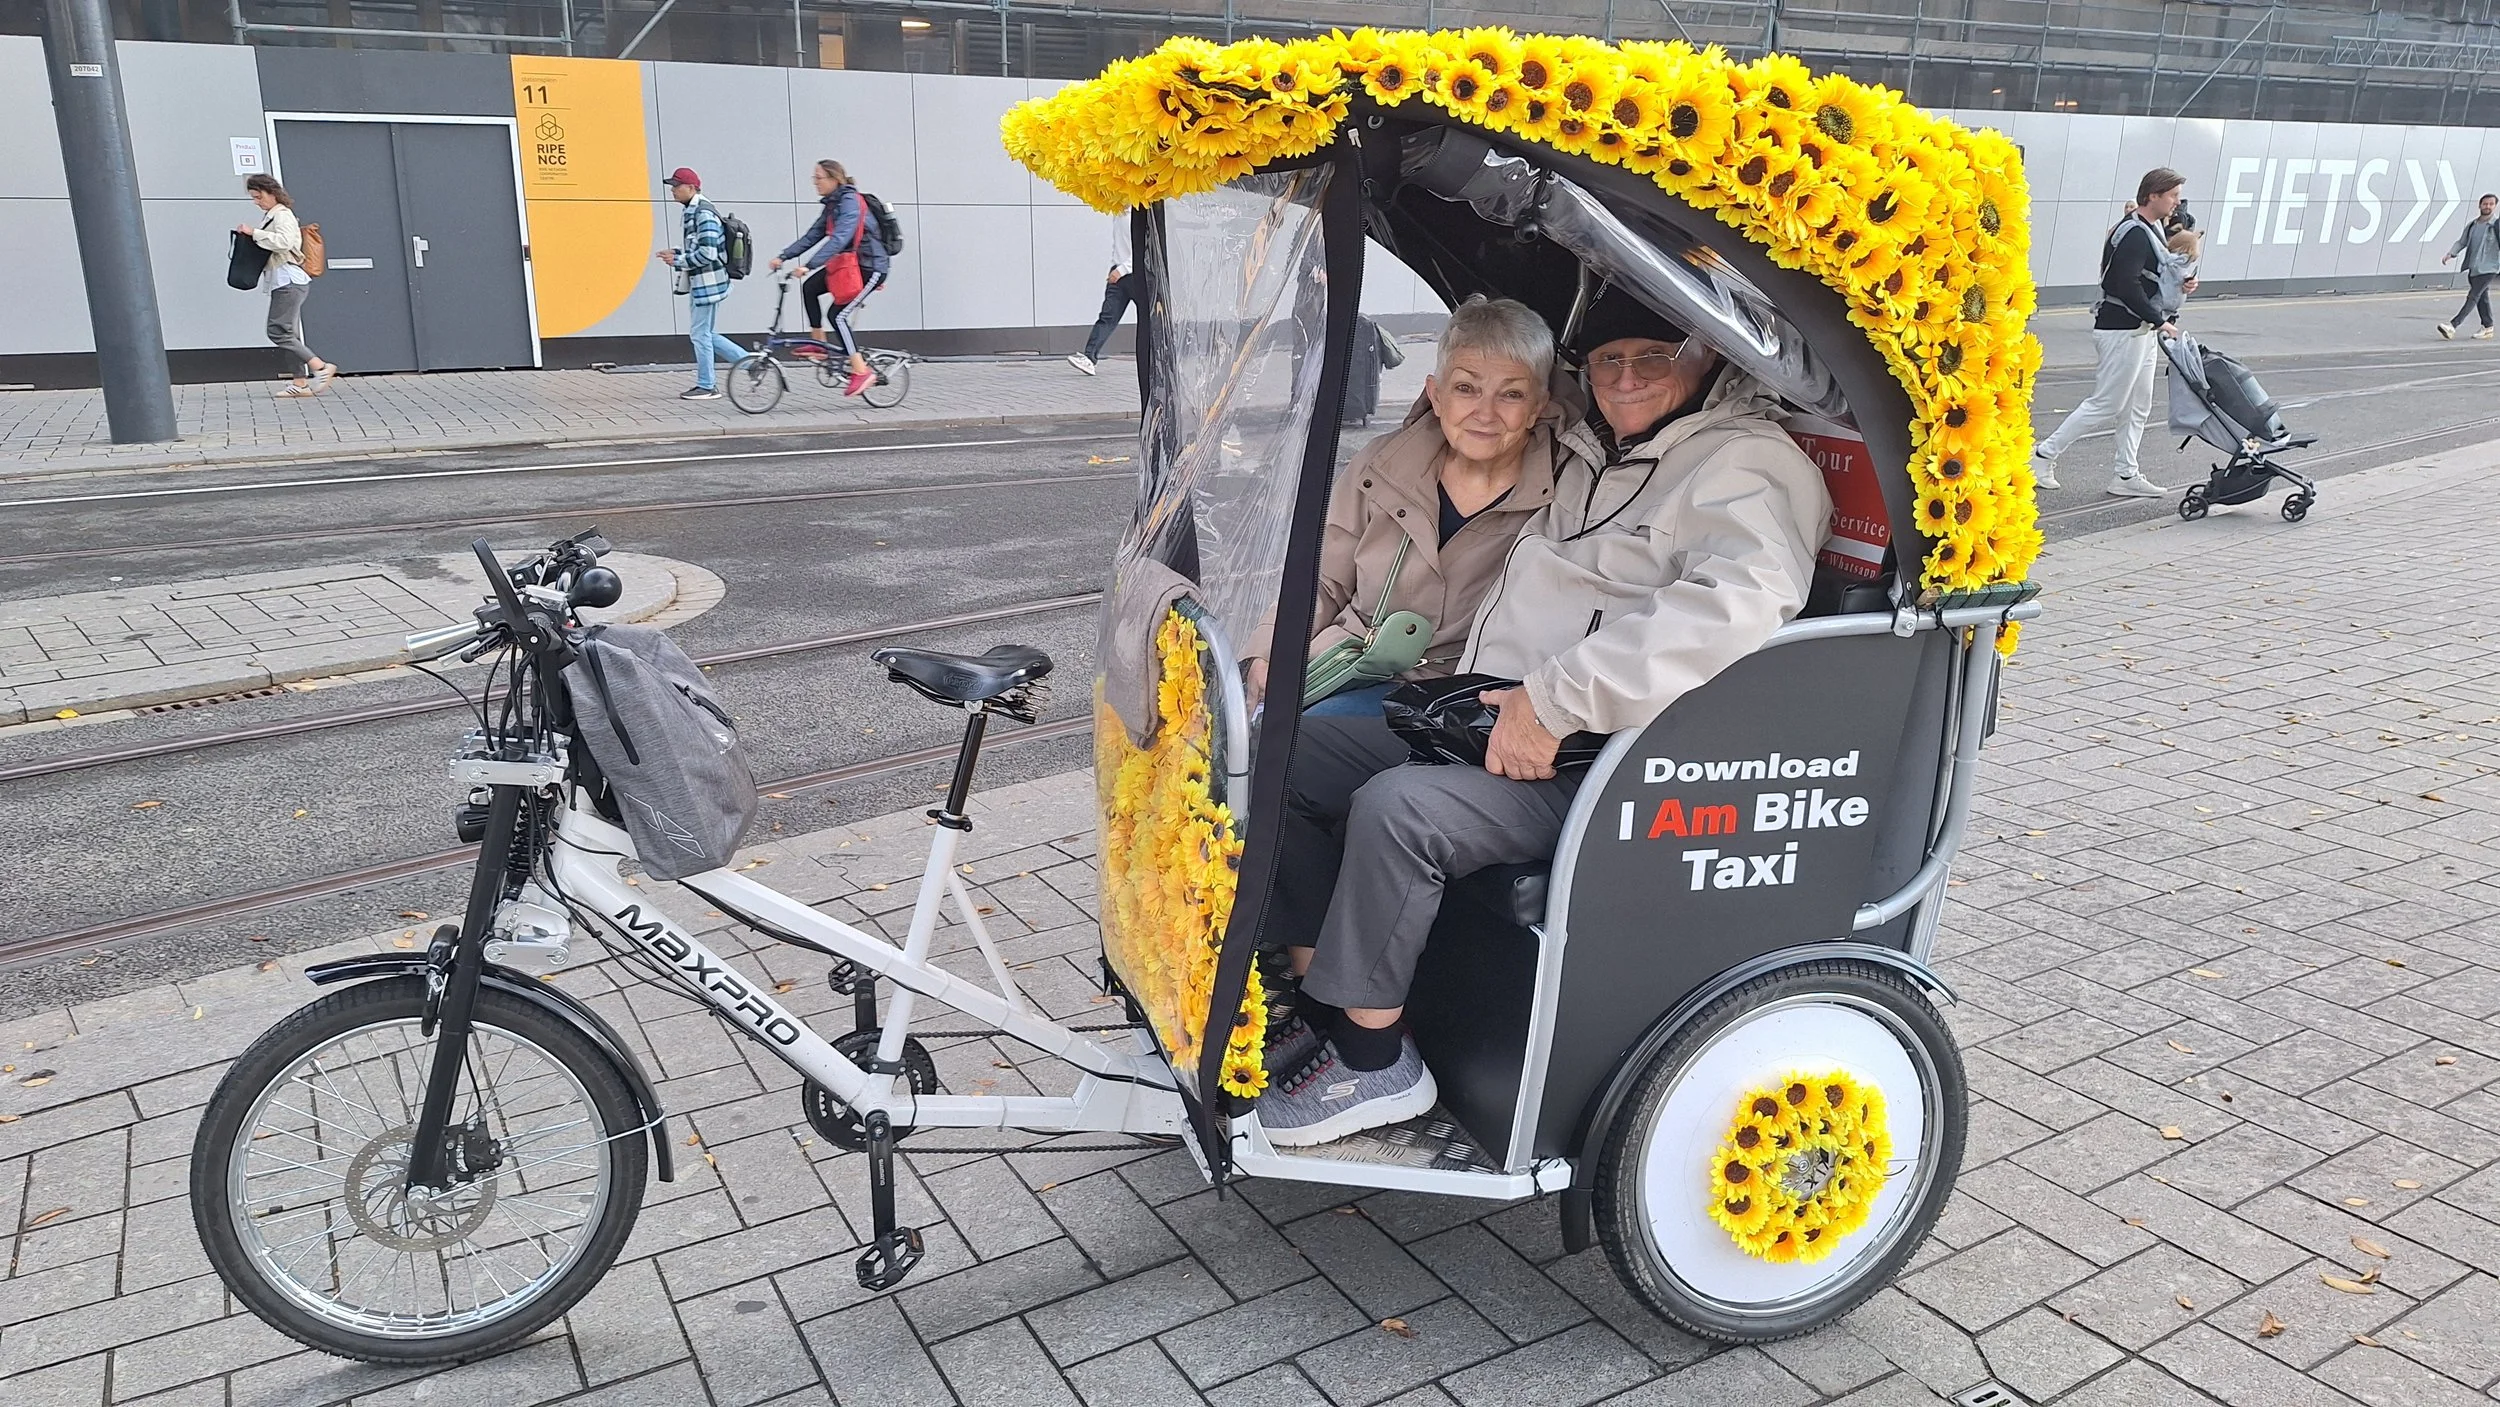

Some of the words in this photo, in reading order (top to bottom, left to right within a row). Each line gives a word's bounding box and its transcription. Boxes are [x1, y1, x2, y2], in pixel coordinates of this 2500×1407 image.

[523, 85, 548, 104] 11
[537, 144, 566, 154] RIPE
[538, 155, 567, 165] NCC
[2216, 156, 2391, 246] FIETS
[1801, 437, 1853, 473] Tour
[1830, 506, 1885, 538] Service
[1642, 749, 1861, 784] Download
[1618, 800, 1636, 841] I
[1647, 797, 1739, 840] Am
[1753, 787, 1870, 833] Bike
[1681, 840, 1799, 892] Taxi
